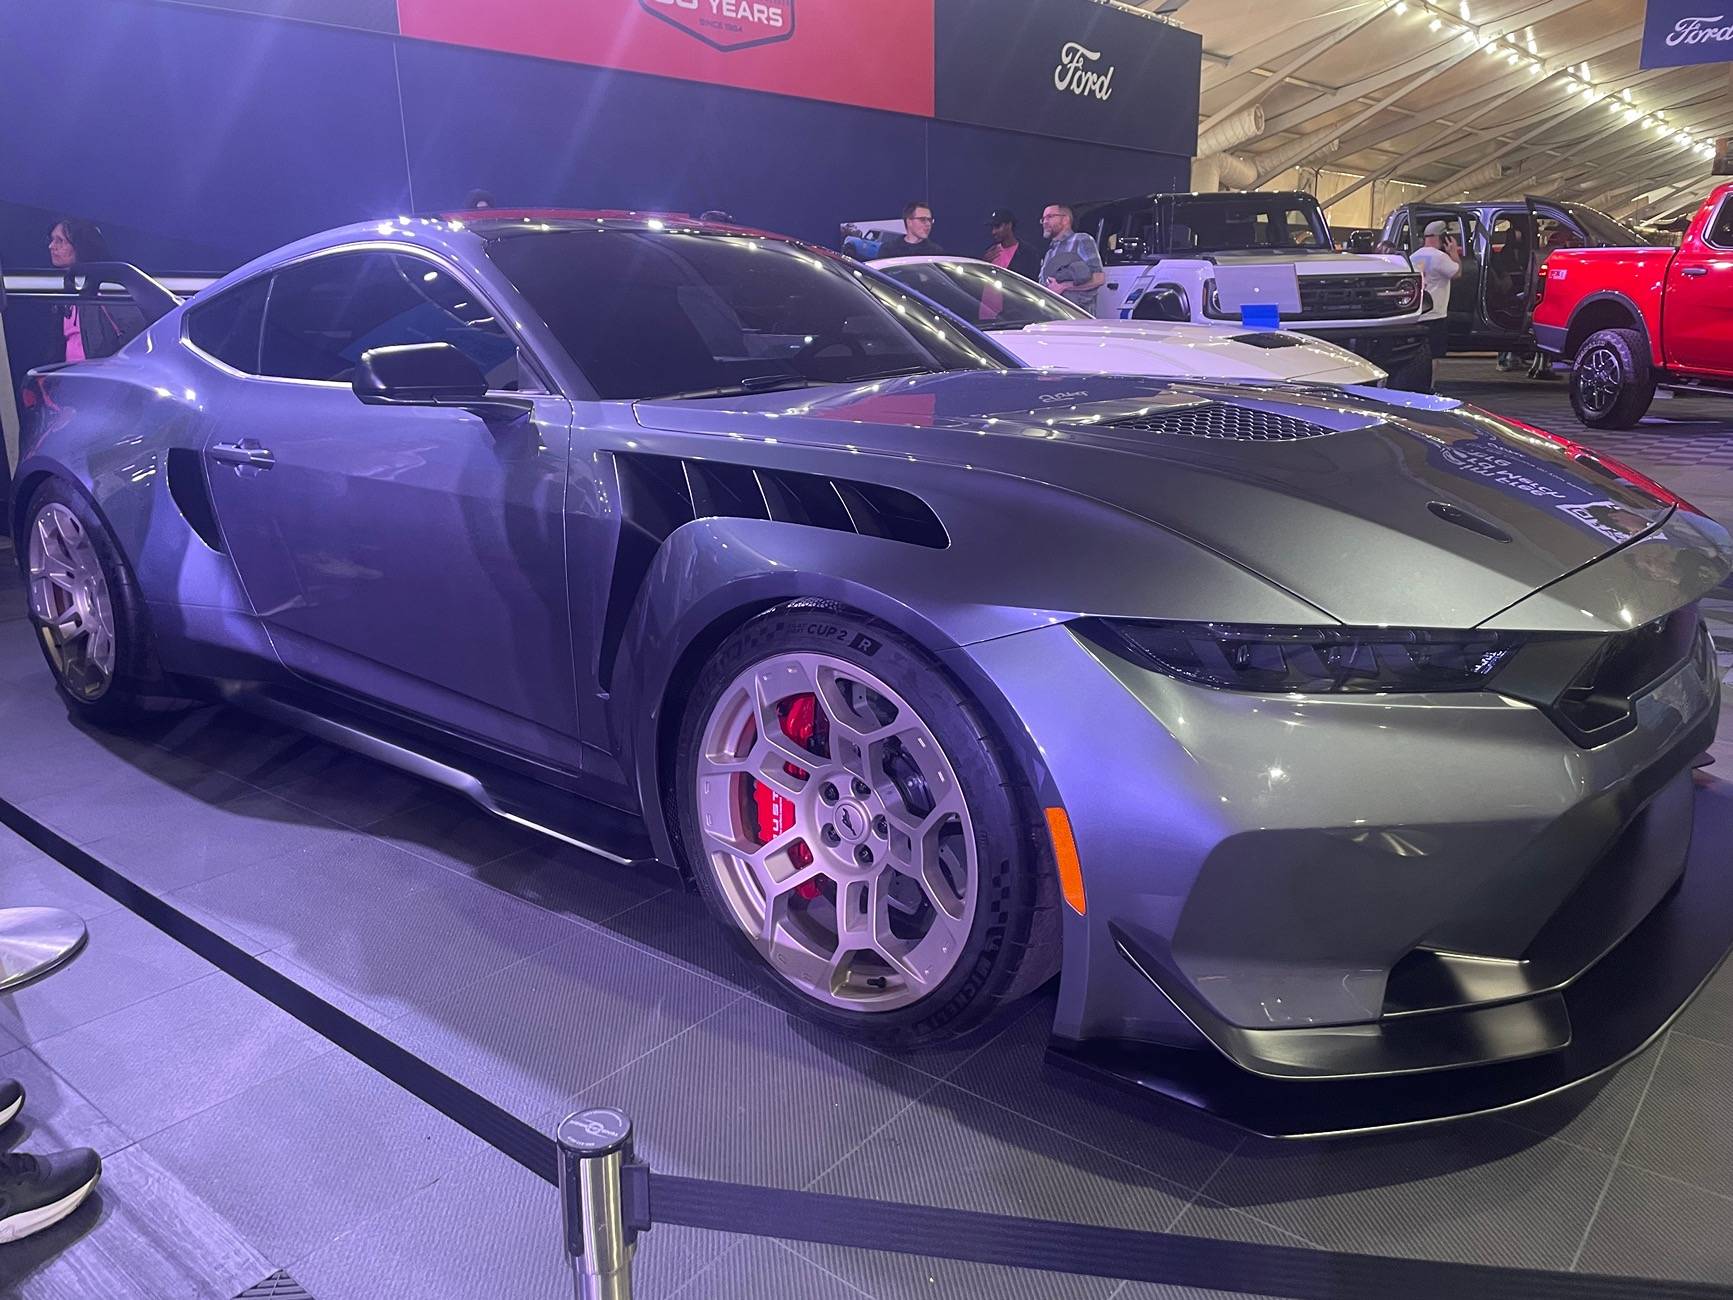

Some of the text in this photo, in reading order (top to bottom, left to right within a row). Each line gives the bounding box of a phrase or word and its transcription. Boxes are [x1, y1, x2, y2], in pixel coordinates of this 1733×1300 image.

[710, 0, 782, 27] YEARS
[1054, 42, 1114, 100] Ford
[808, 624, 837, 637] CUP
[837, 630, 848, 640] 2
[858, 638, 872, 651] R
